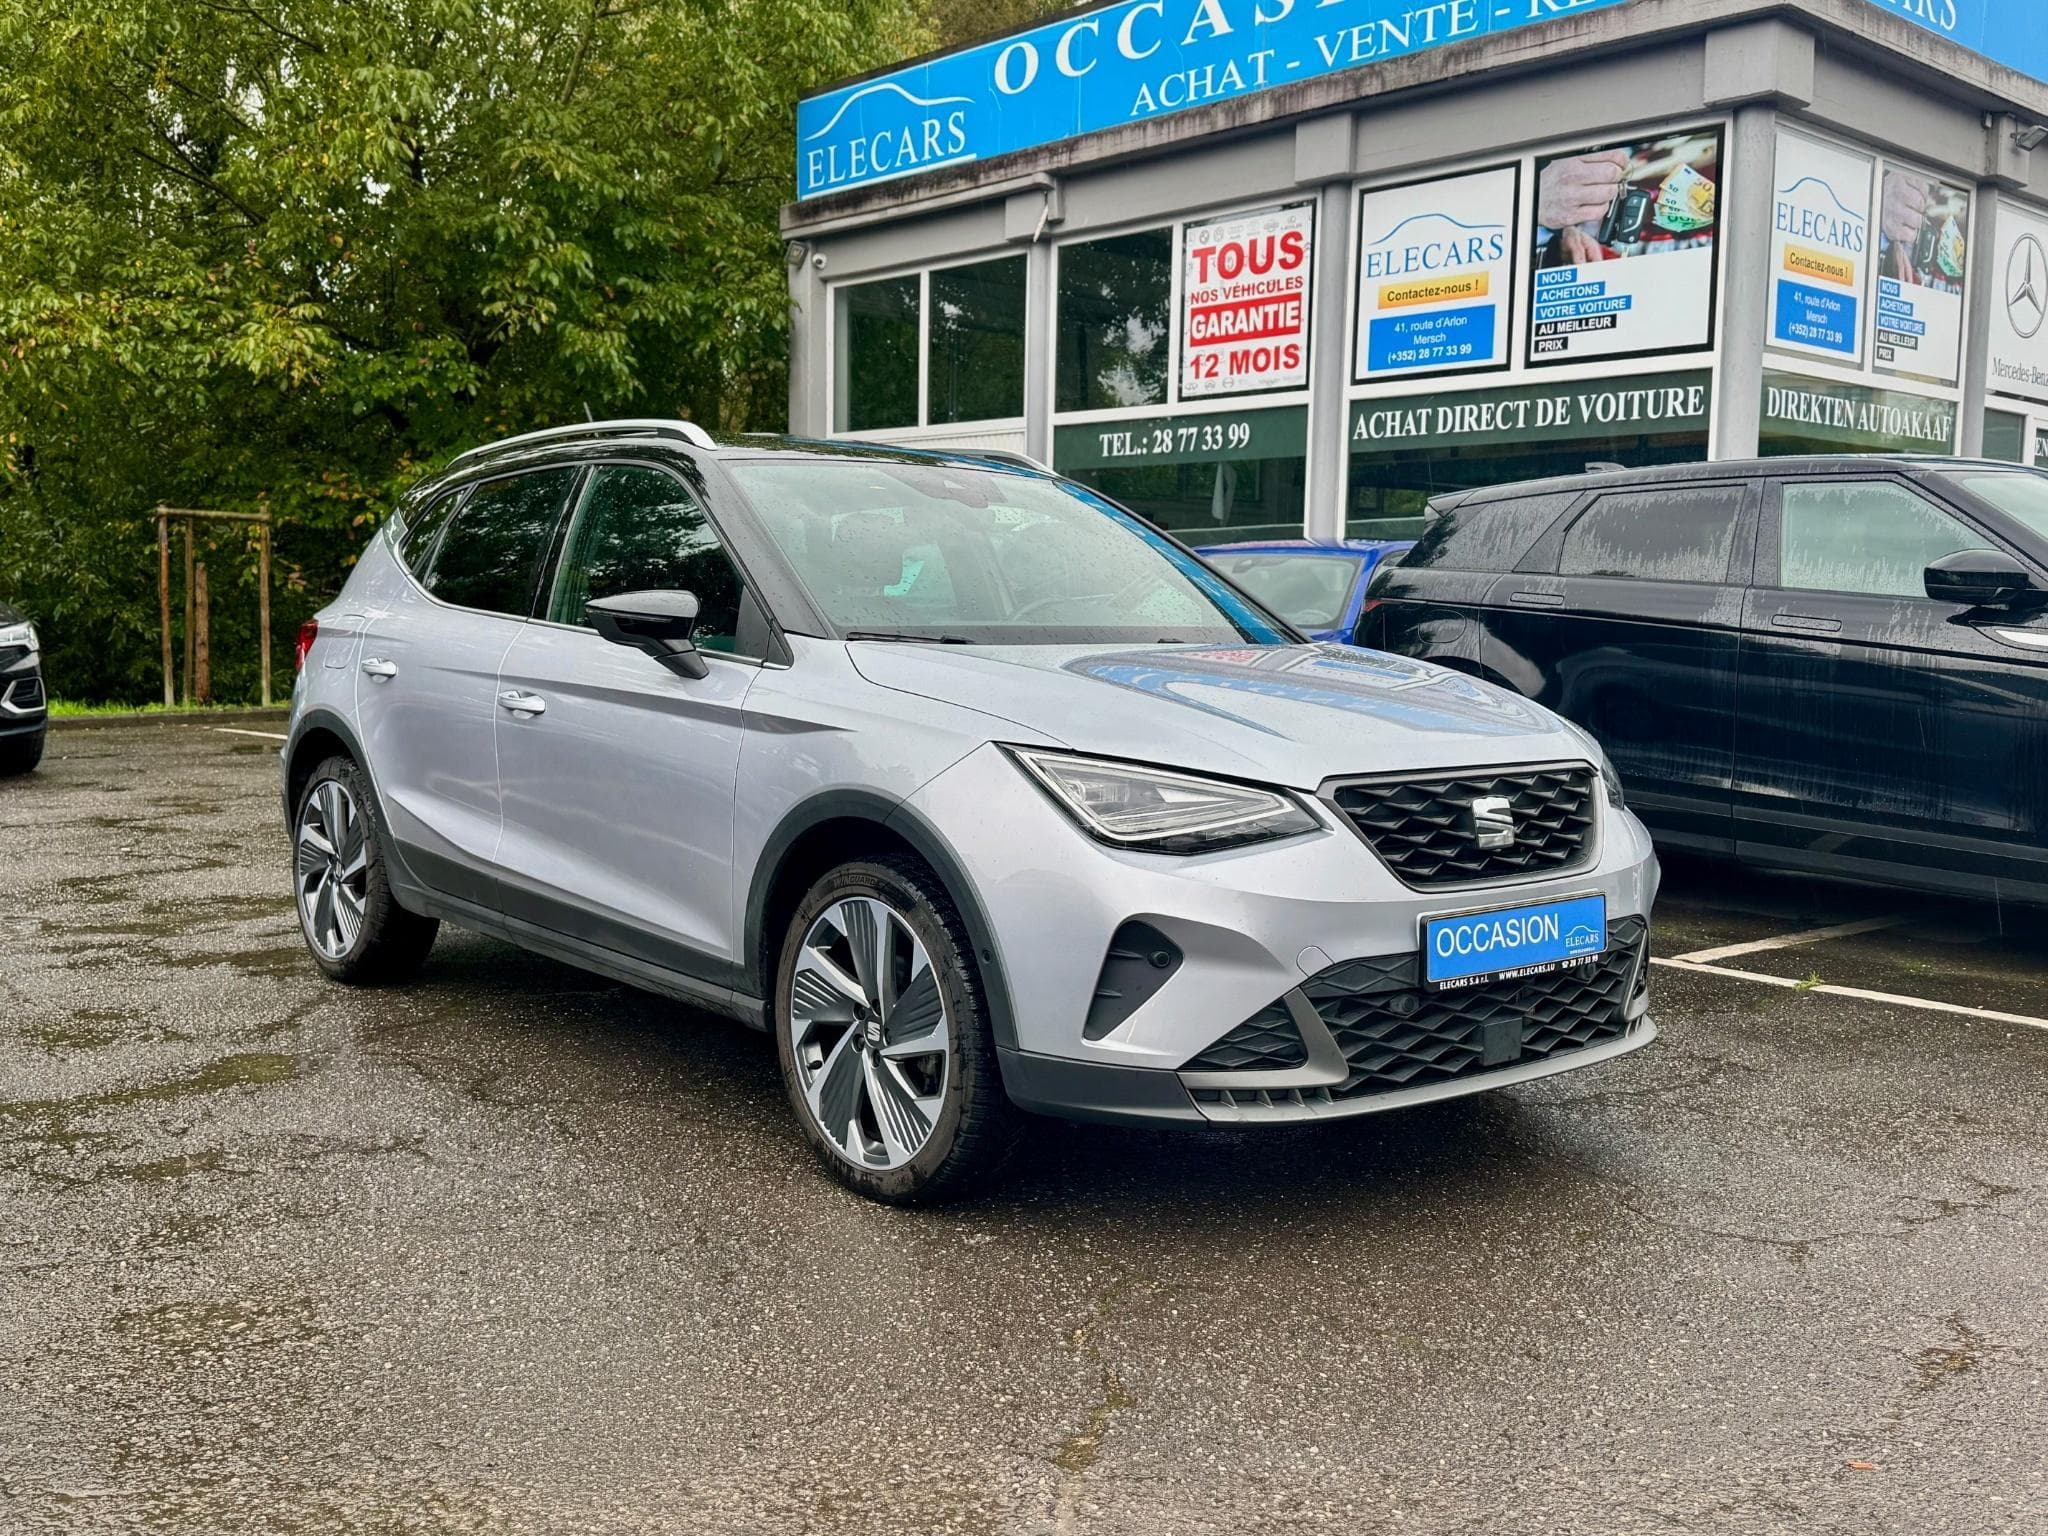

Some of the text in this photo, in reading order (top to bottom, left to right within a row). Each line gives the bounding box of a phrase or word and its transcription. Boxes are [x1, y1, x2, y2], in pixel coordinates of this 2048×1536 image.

[1129, 49, 1274, 116] ACHAT
[1314, 0, 1478, 67] VENTE
[806, 111, 967, 190] ELECARS
[1776, 201, 1863, 253] ELECARS
[1192, 231, 1304, 283] TOUS
[1367, 233, 1504, 278] ELECARS
[1790, 252, 1844, 277] Contactez-nous
[1541, 271, 1572, 284] NOUS
[1881, 280, 1898, 294] NOUS
[1190, 276, 1304, 305] NOS VÉHICULES
[1387, 282, 1472, 302] Contactez-nous
[1540, 284, 1599, 302] ACHETONS
[1540, 298, 1626, 318] VOTRE VOITURE
[1191, 301, 1300, 339] GARANTIE
[1394, 316, 1467, 333] 41, route d'Arlon
[1539, 317, 1611, 335] AU MEILLEUR
[1413, 333, 1447, 345] Mersch
[1538, 339, 1563, 352] PRIX
[1190, 344, 1300, 379] 12 MOIS
[1387, 343, 1472, 363] (+352) 28 77 33 99
[1352, 386, 1705, 439] ACHAT DIRECT DE VOITURE
[1766, 386, 1952, 443] DIREKTEN AUTOAKAAF
[1099, 422, 1249, 457] TEL.: 28 77 33 99
[1436, 913, 1559, 957] OCCASION
[1565, 933, 1599, 947] ELECARS
[1499, 963, 1556, 980] WWW.ELECARS.LU
[1439, 978, 1468, 990] ELECARS
